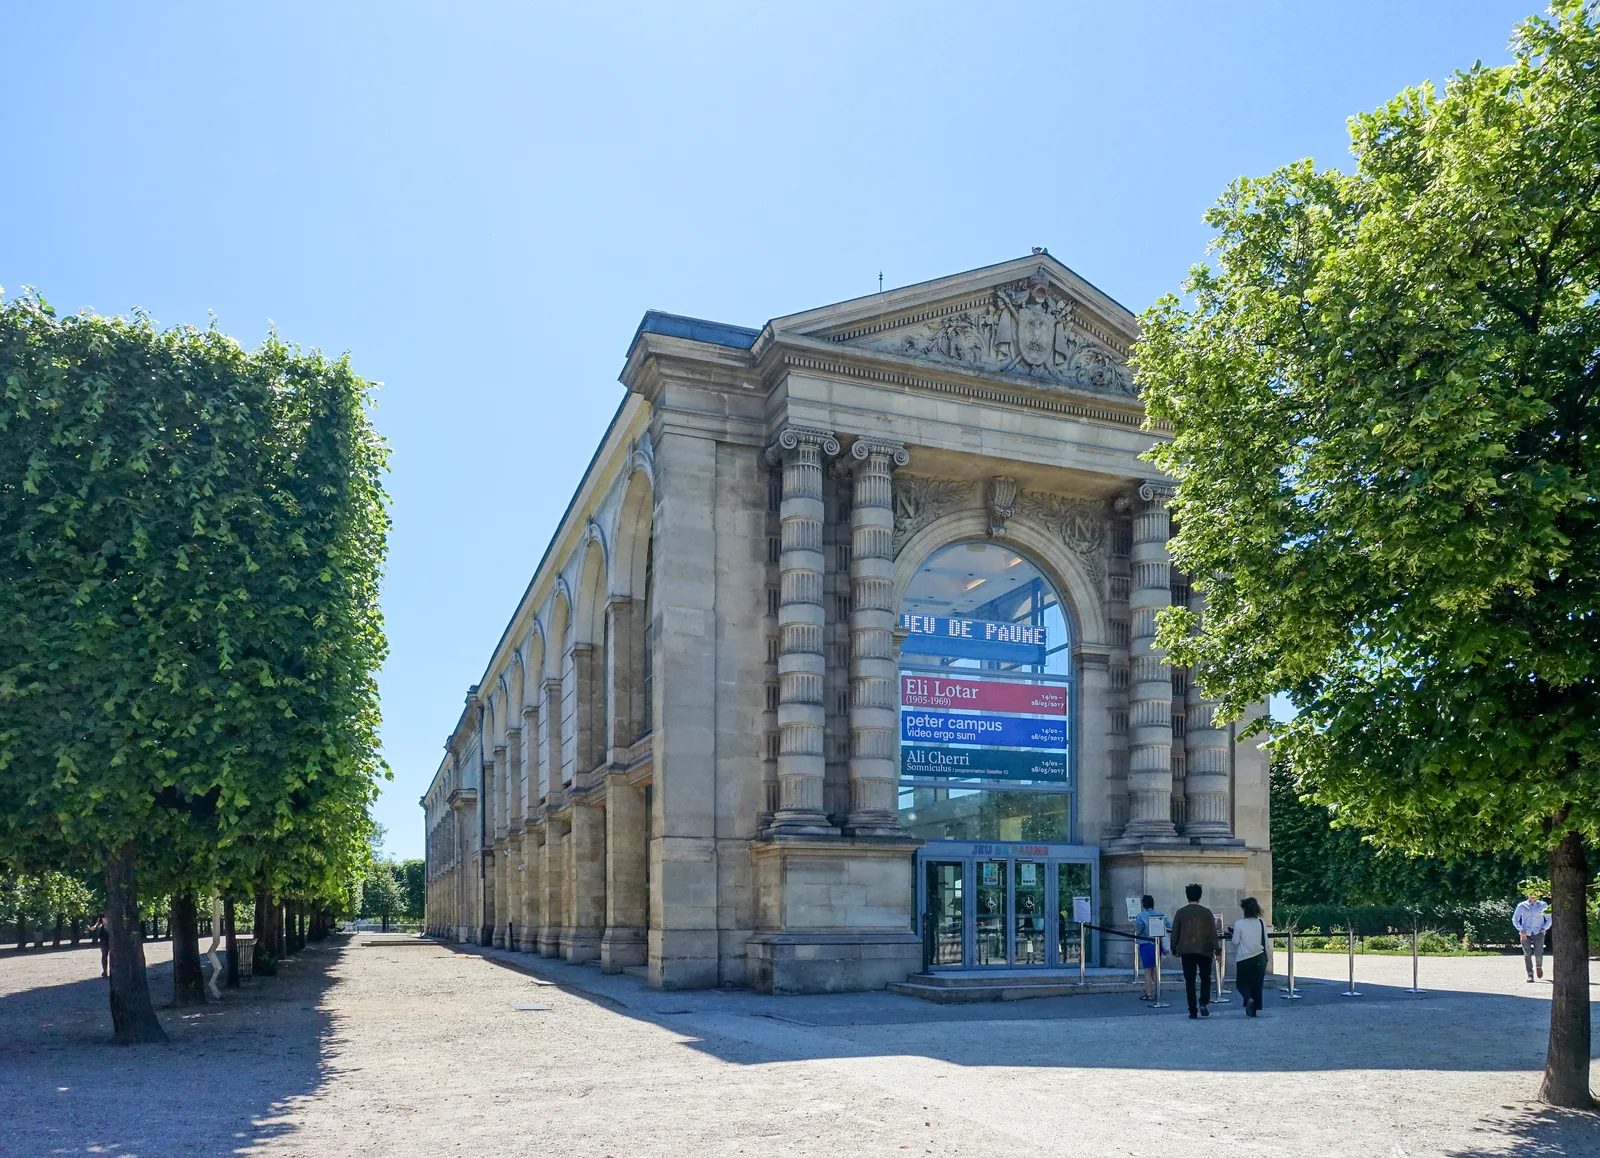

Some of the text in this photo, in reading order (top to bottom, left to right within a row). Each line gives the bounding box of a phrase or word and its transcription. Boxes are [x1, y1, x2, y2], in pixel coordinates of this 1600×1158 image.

[1075, 516, 1092, 541] N
[899, 614, 1045, 645] JEU DE PAUME
[906, 678, 979, 699] Eli Lotar
[905, 695, 951, 706] (1905-1969)
[1031, 700, 1064, 708] 28/05/2017
[906, 714, 1003, 733] peter campus
[907, 727, 976, 741] video ergo sum
[1031, 734, 1064, 742] 28/05/2017
[906, 750, 970, 765] Ali Cherri
[906, 762, 952, 772] Somniculus
[1031, 766, 1064, 775] 28/05/2017
